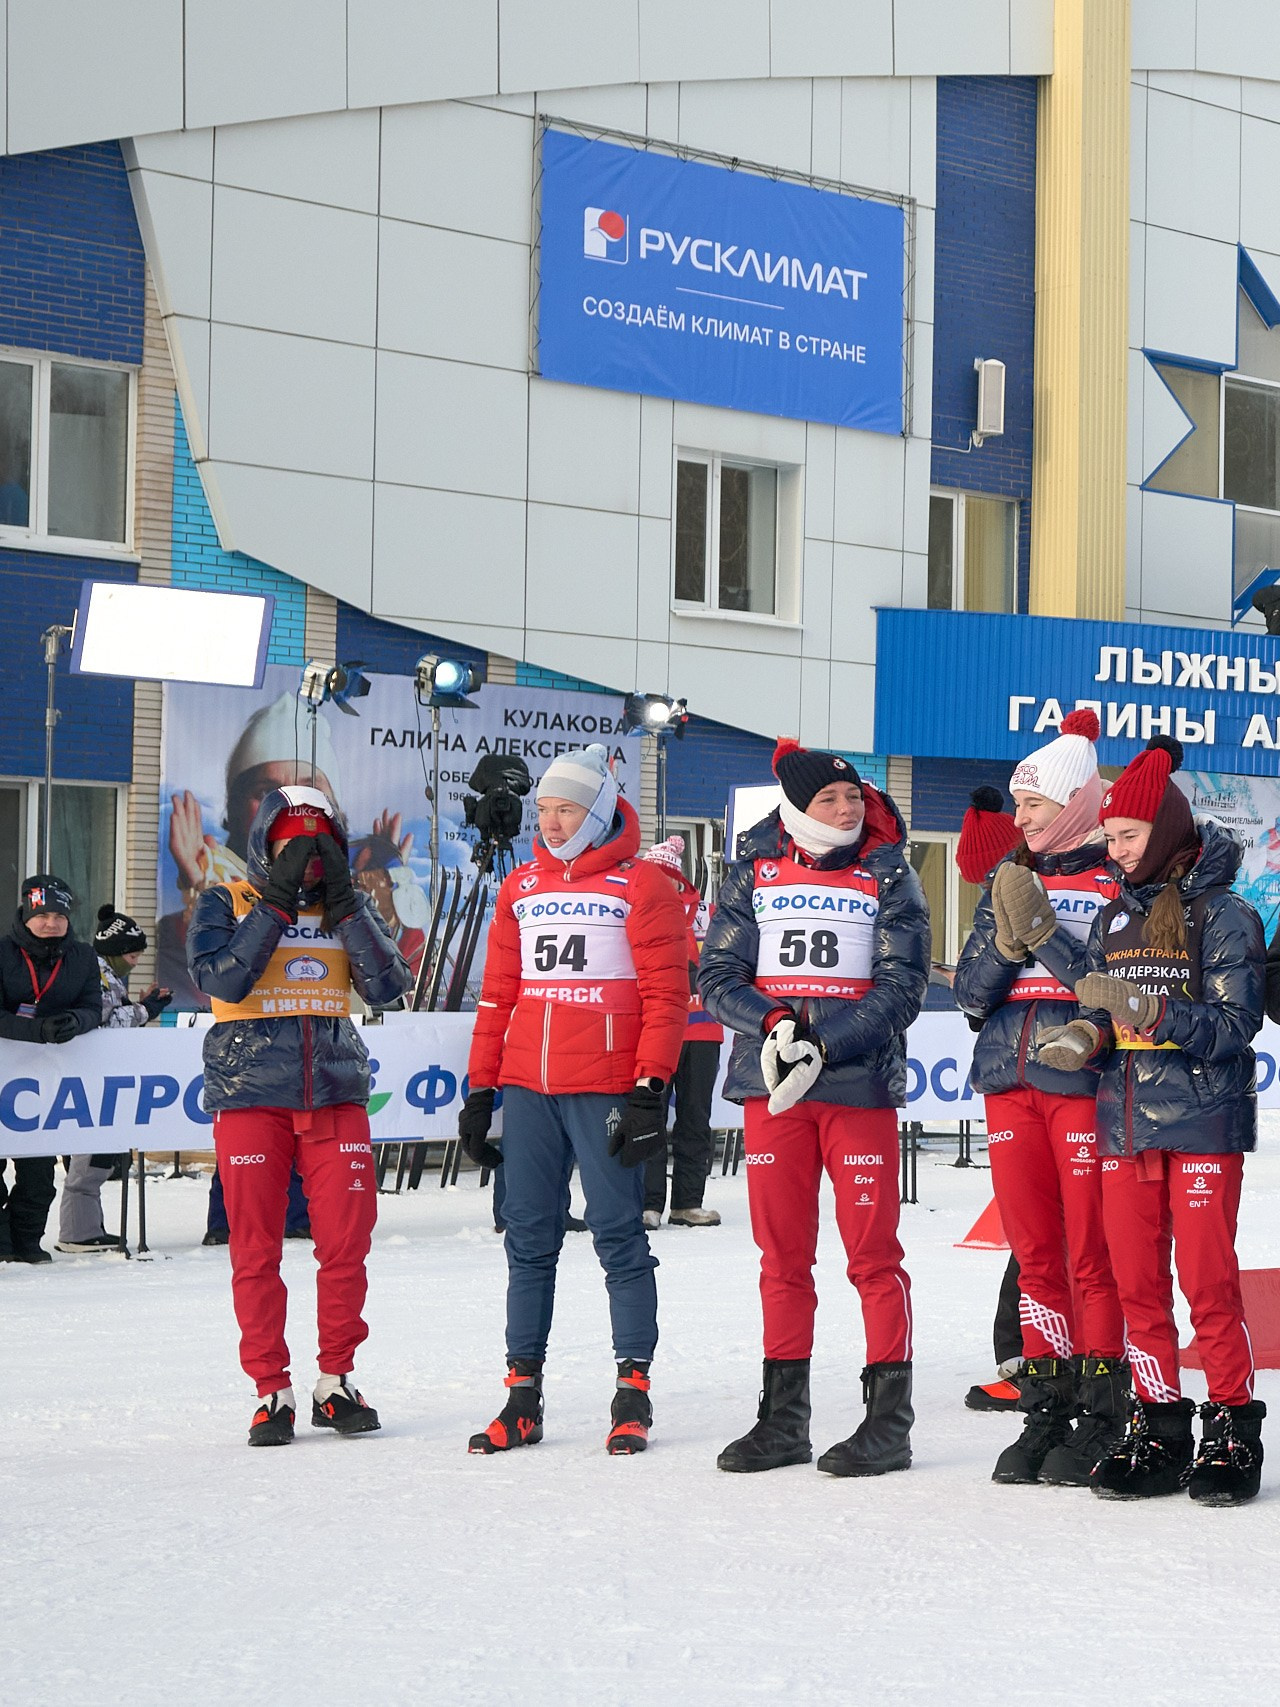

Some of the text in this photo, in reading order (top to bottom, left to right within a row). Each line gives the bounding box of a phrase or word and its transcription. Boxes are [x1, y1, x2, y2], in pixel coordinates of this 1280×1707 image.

[639, 227, 868, 300] РУСКЛИМАТ
[583, 296, 866, 364] СОЗДАЁМ КЛИМАТ В СТРАНЕ
[503, 708, 625, 736] КУЛАКОВА
[370, 727, 467, 753] ГАЛИНА
[288, 807, 319, 817] LUKO
[445, 831, 467, 842] 1972
[531, 901, 625, 918] ФОСАГРО
[771, 894, 877, 918] ФОСАГРО
[534, 934, 588, 972] 54
[779, 929, 840, 969] 58
[1142, 947, 1189, 961] СТРАНА
[1126, 965, 1190, 980] ДЕРЗКАЯ
[274, 987, 319, 996] России
[322, 988, 345, 997] 2025
[1066, 1131, 1096, 1143] LUKO
[339, 1143, 372, 1154] LUKOIL
[230, 1153, 266, 1165] BOSCO
[843, 1154, 884, 1165] LUKOIL
[1182, 1162, 1222, 1174] LUKOIL
